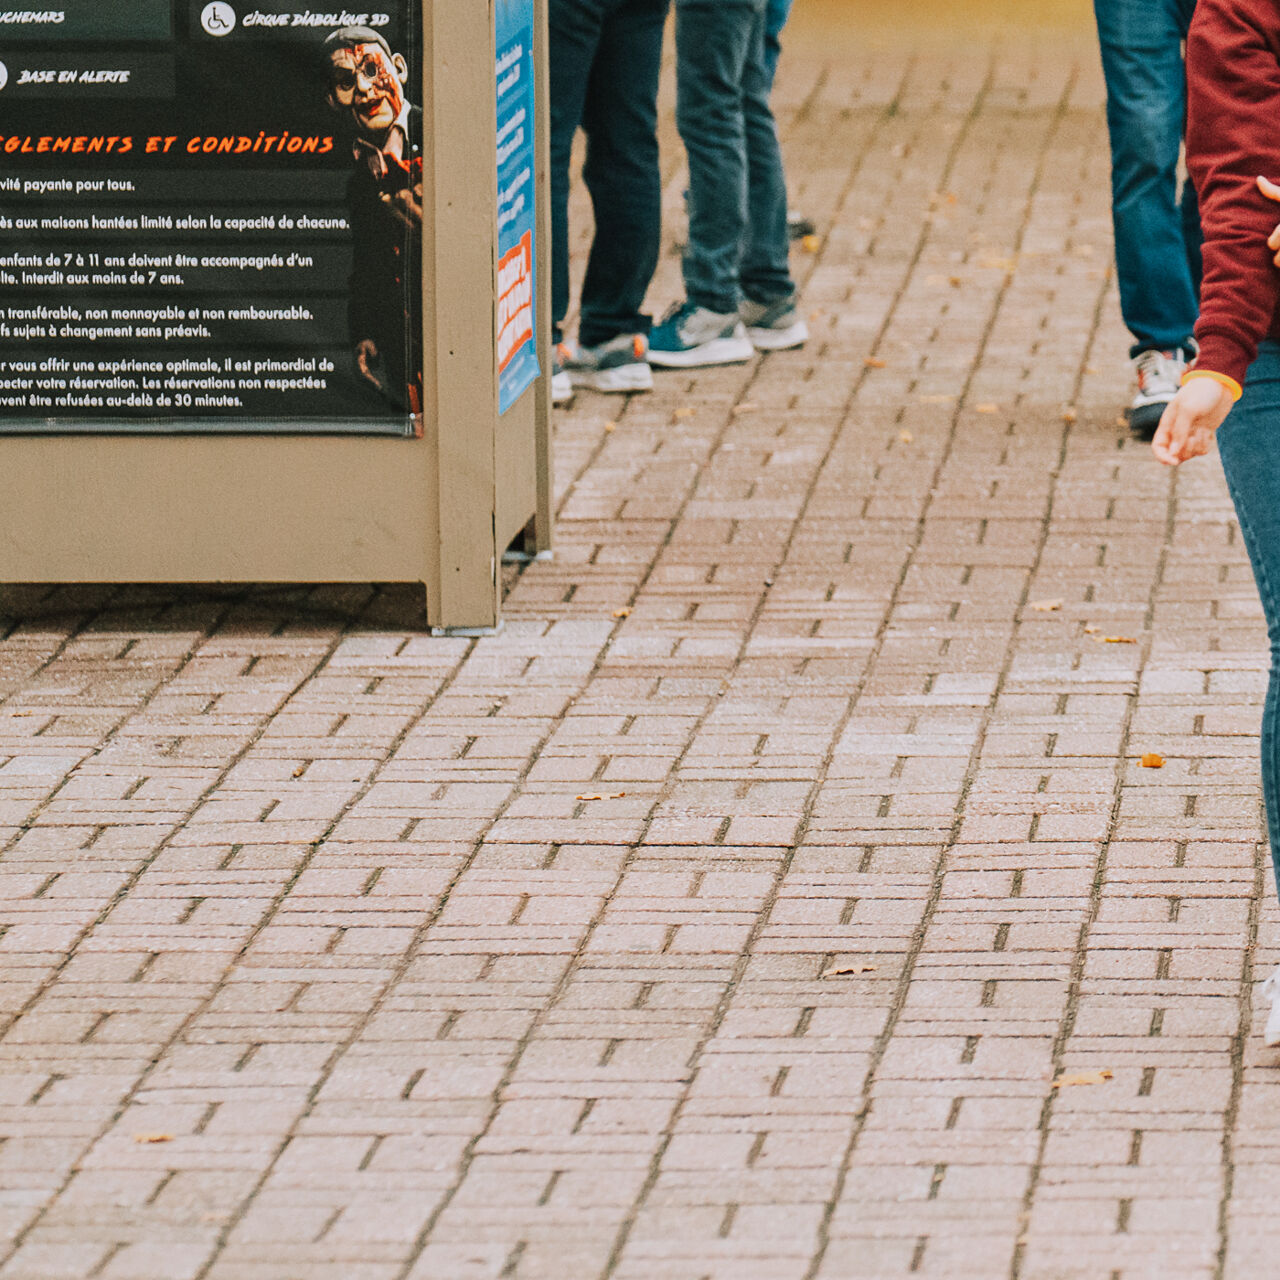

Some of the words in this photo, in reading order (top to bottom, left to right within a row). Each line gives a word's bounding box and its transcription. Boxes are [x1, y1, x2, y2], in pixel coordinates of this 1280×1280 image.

[242, 10, 291, 27] CIRQUE
[291, 10, 368, 28] DIABOLIQUE
[17, 70, 56, 84] BASE
[58, 70, 77, 82] EN
[79, 71, 130, 83] ALERTE
[146, 136, 177, 153] ET
[187, 131, 333, 153] CONDITIONS
[24, 179, 72, 193] payante
[76, 181, 104, 193] pour
[107, 179, 135, 190] tous.
[16, 219, 38, 228] aux
[41, 216, 89, 228] maisons
[92, 215, 138, 229] hantées
[141, 215, 172, 229] limité
[176, 215, 206, 229] selon
[210, 215, 221, 228] la
[225, 216, 275, 231] capacité
[278, 215, 293, 228] de
[297, 215, 349, 229] chacune.
[46, 253, 60, 266] de
[64, 254, 72, 266] 7
[76, 254, 84, 266] à
[89, 254, 98, 266] 11
[105, 257, 125, 266] ans
[128, 253, 172, 266] doivent
[175, 254, 198, 266] être
[201, 254, 283, 269] accompagnés
[22, 271, 63, 284] Interdit
[67, 275, 89, 284] aux
[93, 272, 126, 284] moins
[130, 271, 145, 284] de
[149, 271, 156, 284] 7
[160, 275, 184, 284] ans.
[8, 306, 81, 321] transférable,
[86, 310, 108, 319] non
[112, 306, 185, 322] monnayable
[188, 308, 199, 319] et
[203, 310, 225, 319] non
[228, 306, 313, 319] remboursable.
[14, 324, 45, 340] sujets
[49, 324, 56, 336] à
[60, 324, 132, 340] changement
[136, 328, 161, 337] sans
[165, 324, 210, 340] préavis.
[9, 362, 36, 371] vous
[40, 358, 70, 371] offrir
[73, 362, 94, 371] une
[98, 359, 163, 374] expérience
[166, 358, 221, 374] optimale,
[225, 358, 231, 371] il
[235, 360, 251, 371] est
[255, 358, 315, 374] primordial
[319, 358, 334, 371] de
[36, 378, 66, 389] votre
[70, 376, 138, 389] réservation.
[143, 377, 161, 389] Les
[164, 376, 235, 389] réservations
[239, 380, 261, 388] non
[265, 376, 326, 392] respectées
[30, 394, 51, 406] être
[56, 393, 103, 406] refusées
[107, 393, 153, 406] au-delà
[156, 393, 171, 406] de
[175, 394, 191, 406] 30
[195, 394, 242, 406] minutes.
